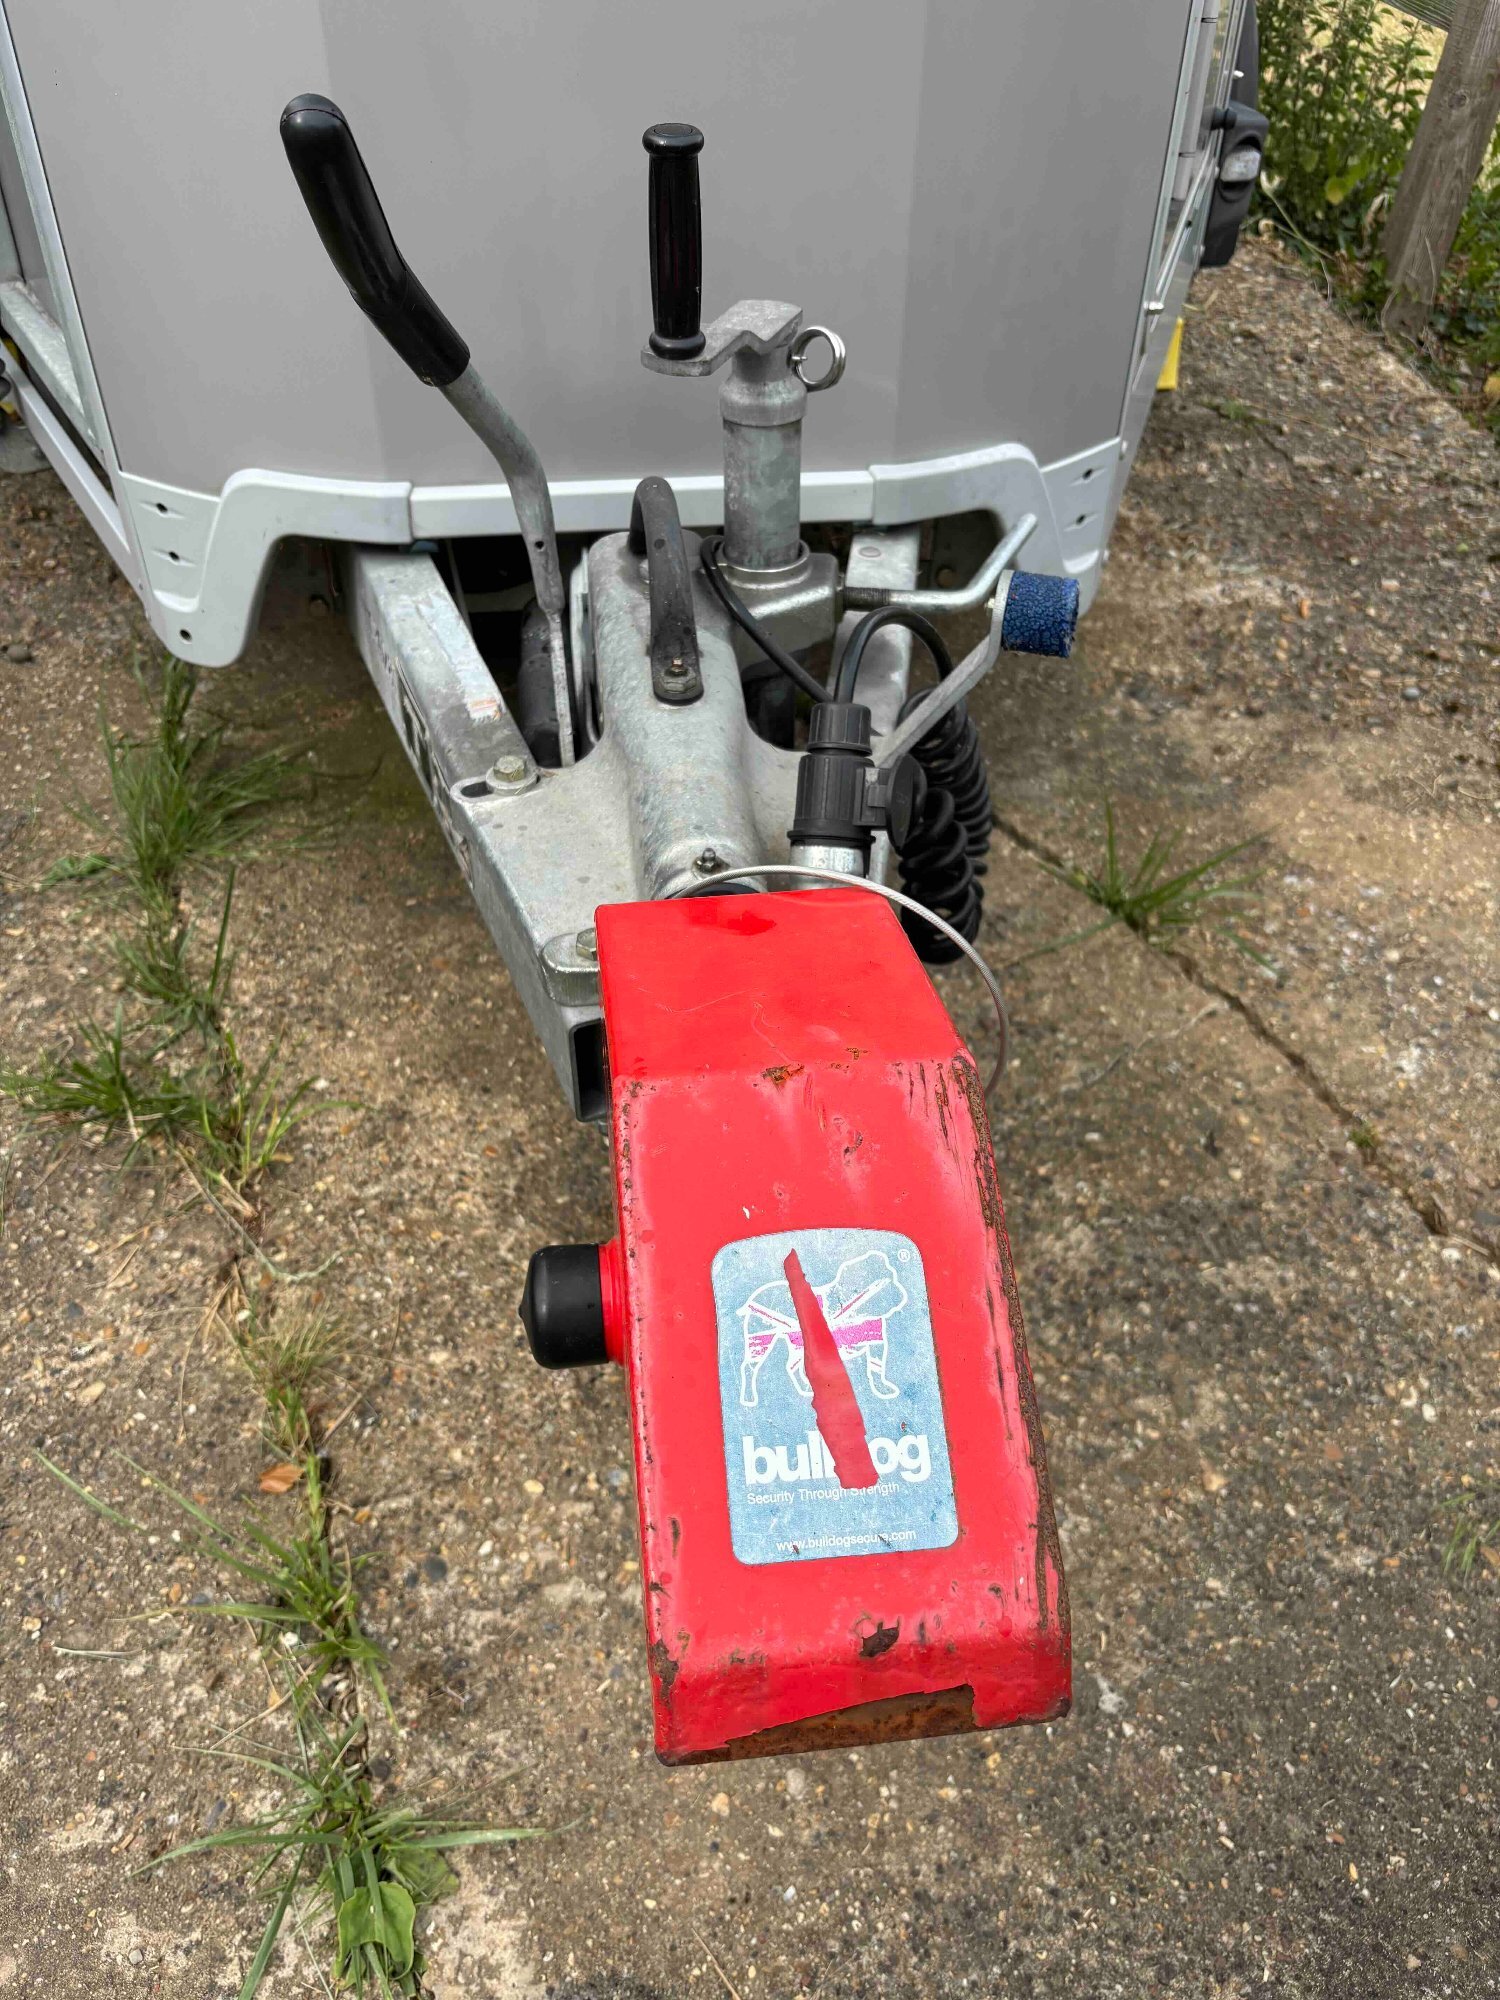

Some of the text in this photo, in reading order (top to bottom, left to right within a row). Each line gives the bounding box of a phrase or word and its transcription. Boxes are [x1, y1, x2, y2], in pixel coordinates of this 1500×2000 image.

[742, 1430, 932, 1484] bullog
[747, 1490, 795, 1504] Security
[776, 1530, 916, 1550] www.bulldogsecure.com
